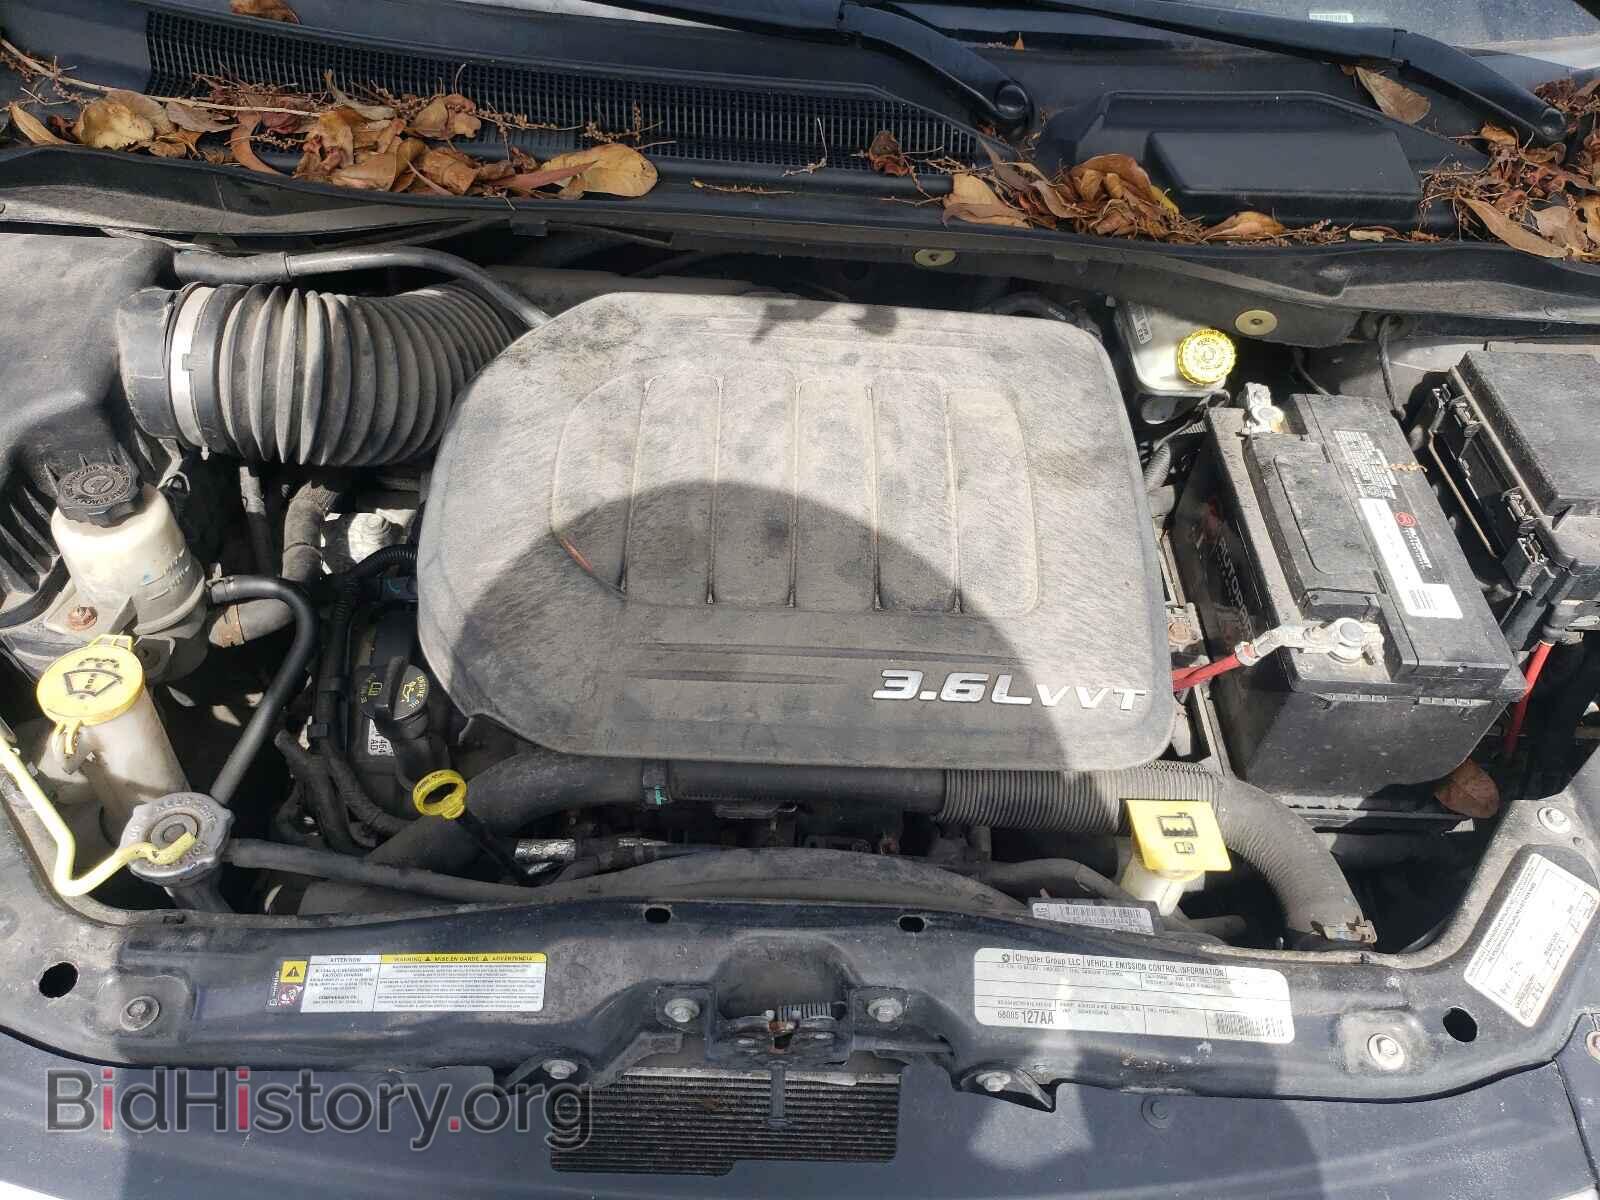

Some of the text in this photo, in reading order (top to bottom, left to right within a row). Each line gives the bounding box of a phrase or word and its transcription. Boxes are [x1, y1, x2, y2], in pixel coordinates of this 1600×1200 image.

[872, 669, 1147, 711] 3.6L VVT
[1015, 953, 1225, 977] Chrysler Group LLC VEHICLE EMISSION CONTROL INFORMATION
[1022, 1010, 1054, 1025] 127AA
